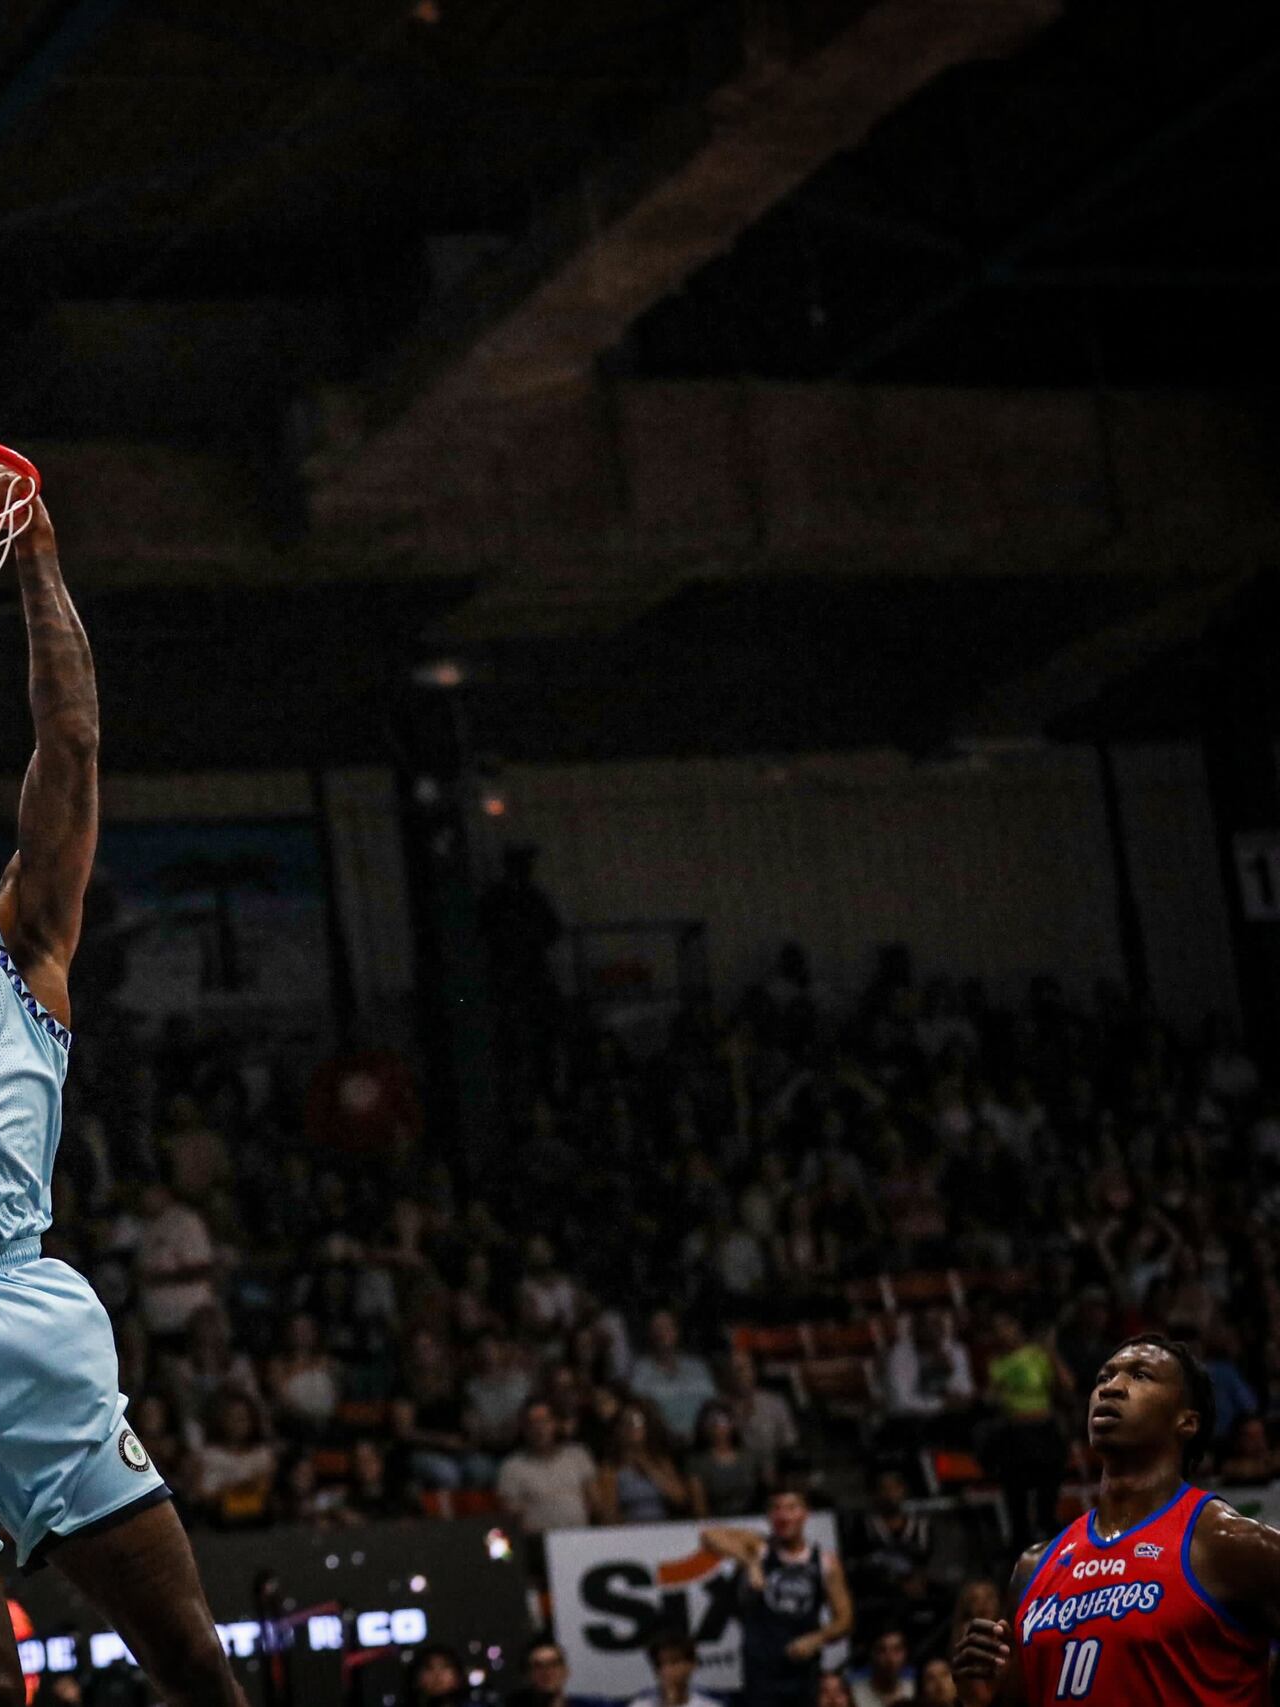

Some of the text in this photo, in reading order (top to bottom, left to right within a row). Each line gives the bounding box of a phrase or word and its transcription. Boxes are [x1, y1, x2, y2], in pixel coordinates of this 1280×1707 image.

[1072, 1558, 1126, 1581] GOYA
[1021, 1581, 1164, 1646] VAQUEROS
[1056, 1638, 1101, 1699] 10
